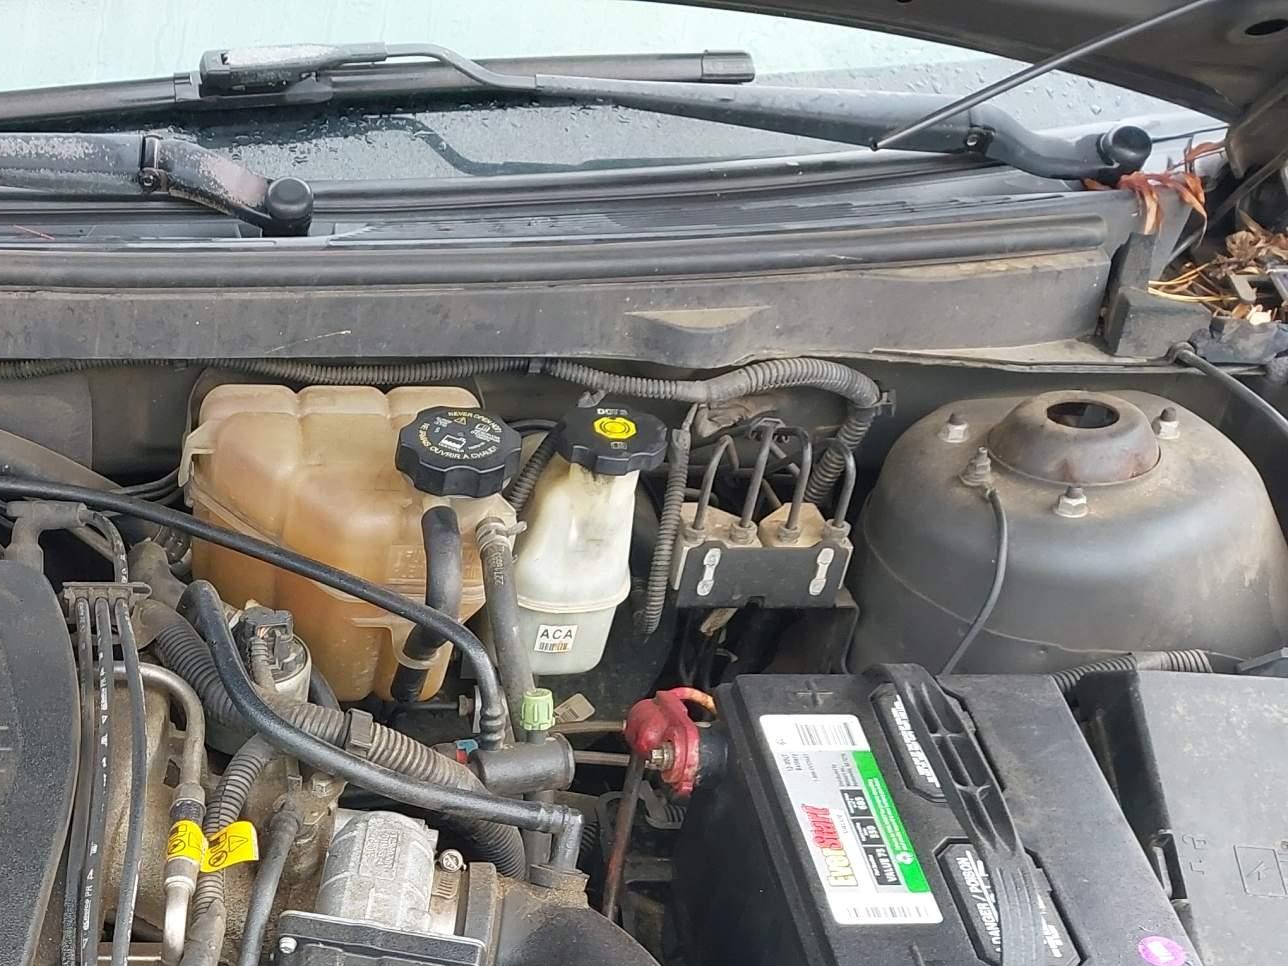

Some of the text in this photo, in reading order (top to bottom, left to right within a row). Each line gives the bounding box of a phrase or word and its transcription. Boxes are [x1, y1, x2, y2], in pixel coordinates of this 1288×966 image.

[540, 628, 573, 640] ACA
[956, 857, 981, 899] POISON
[977, 902, 1001, 946] DANGER
